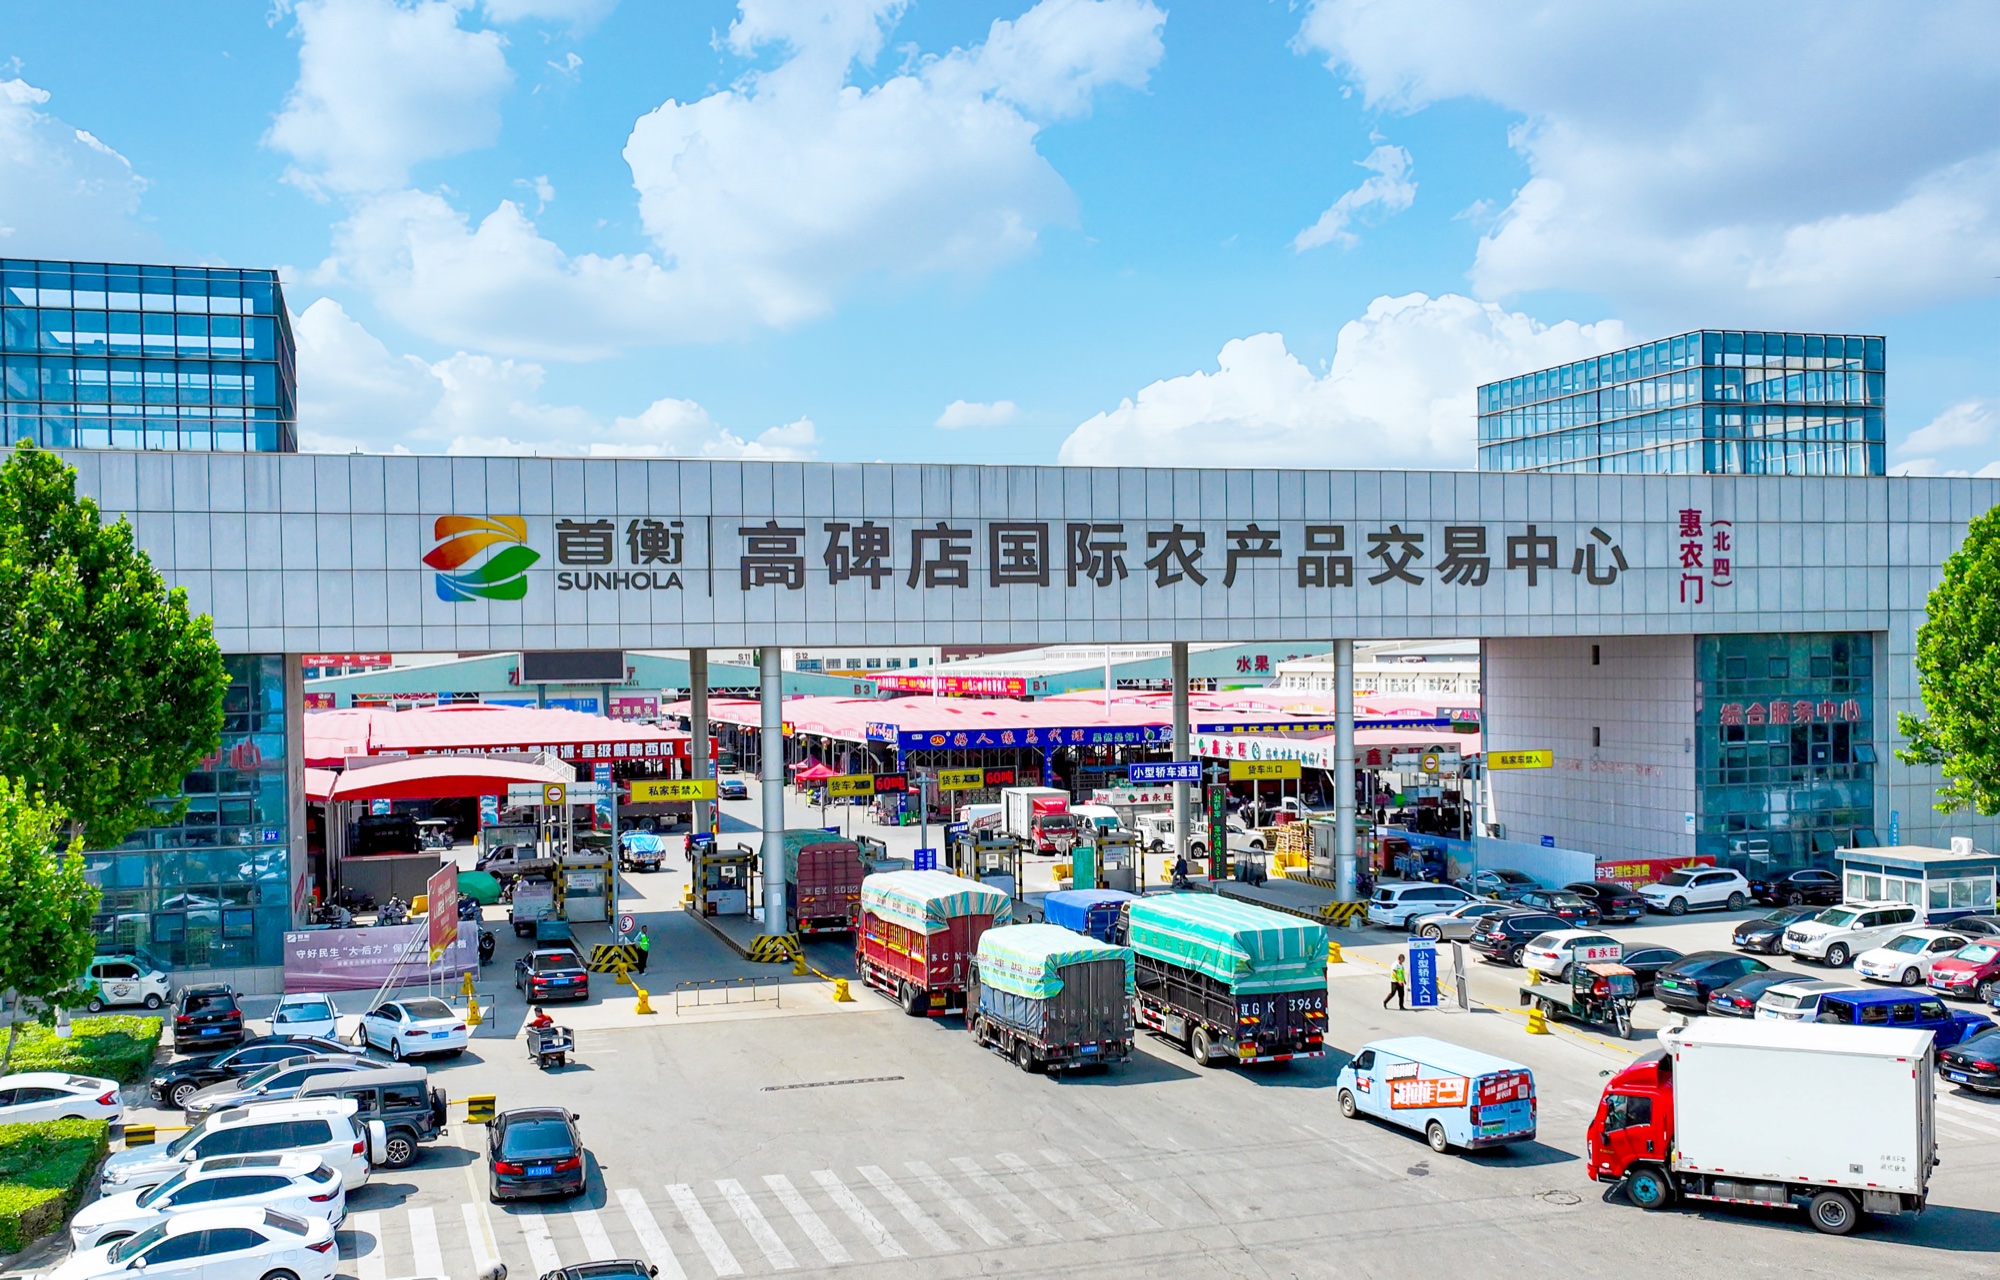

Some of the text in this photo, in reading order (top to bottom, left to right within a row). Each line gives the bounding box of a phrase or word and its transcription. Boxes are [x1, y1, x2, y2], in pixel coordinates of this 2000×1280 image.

[555, 519, 684, 565] 首衡
[738, 520, 1629, 591] 高碑店国际农产品交易中心
[1679, 508, 1704, 605] 惠农门
[557, 571, 684, 591] SUNHOLA
[1720, 698, 1862, 725] 综合服务中心
[1212, 739, 1247, 759] 鑫永旺
[1500, 753, 1542, 764] 私家车禁入
[1133, 765, 1199, 779] 小型轿车通道
[1248, 764, 1283, 775] 货车出口
[648, 785, 701, 797] 私家车禁入
[1595, 864, 1650, 879] 牢记理性消费
[1587, 947, 1619, 958] 鑫永旺
[1417, 950, 1431, 1004] 小型轿车入口
[1288, 997, 1322, 1012] 3966
